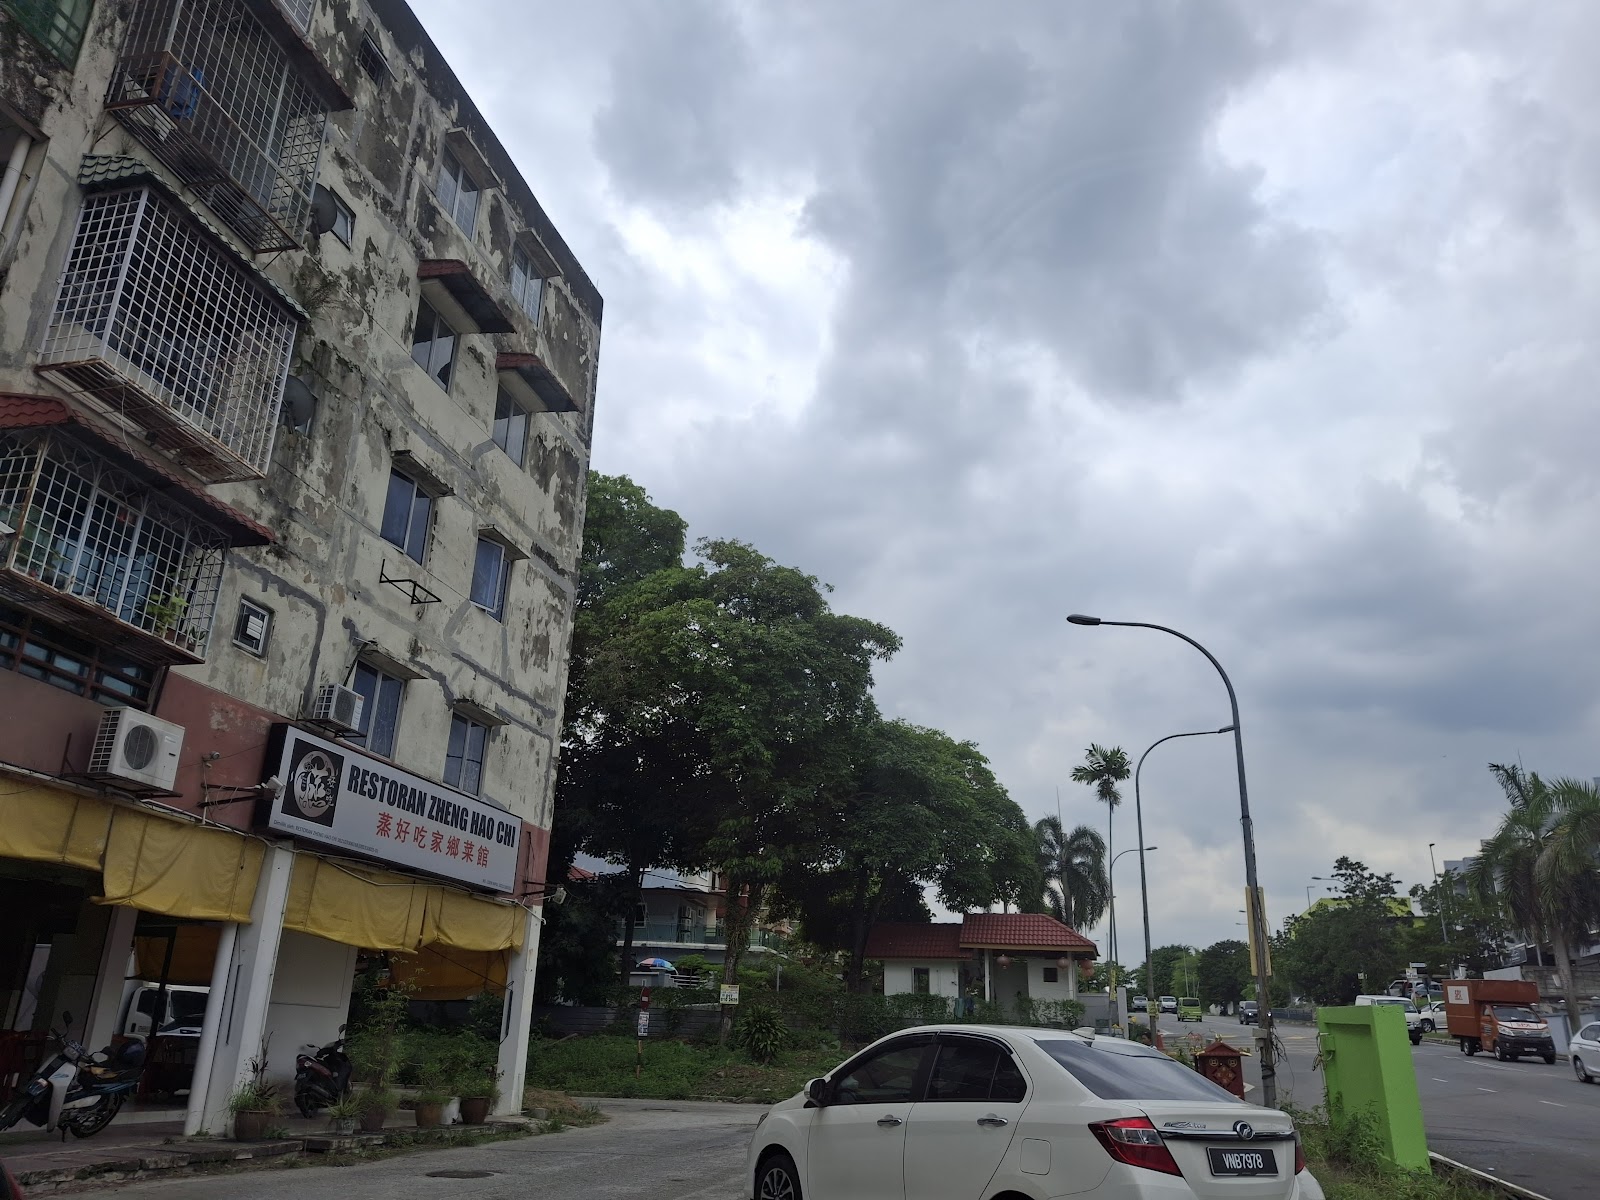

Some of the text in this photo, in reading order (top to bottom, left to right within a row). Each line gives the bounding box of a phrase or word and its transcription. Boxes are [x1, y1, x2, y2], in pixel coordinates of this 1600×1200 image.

[347, 764, 427, 817] RESTORAN
[427, 795, 469, 831] ZHENG
[469, 810, 495, 841] HAO
[496, 821, 516, 848] CHI
[376, 811, 489, 869] 蒸好吃家鄉菜館
[1222, 1153, 1264, 1169] VNB7978
